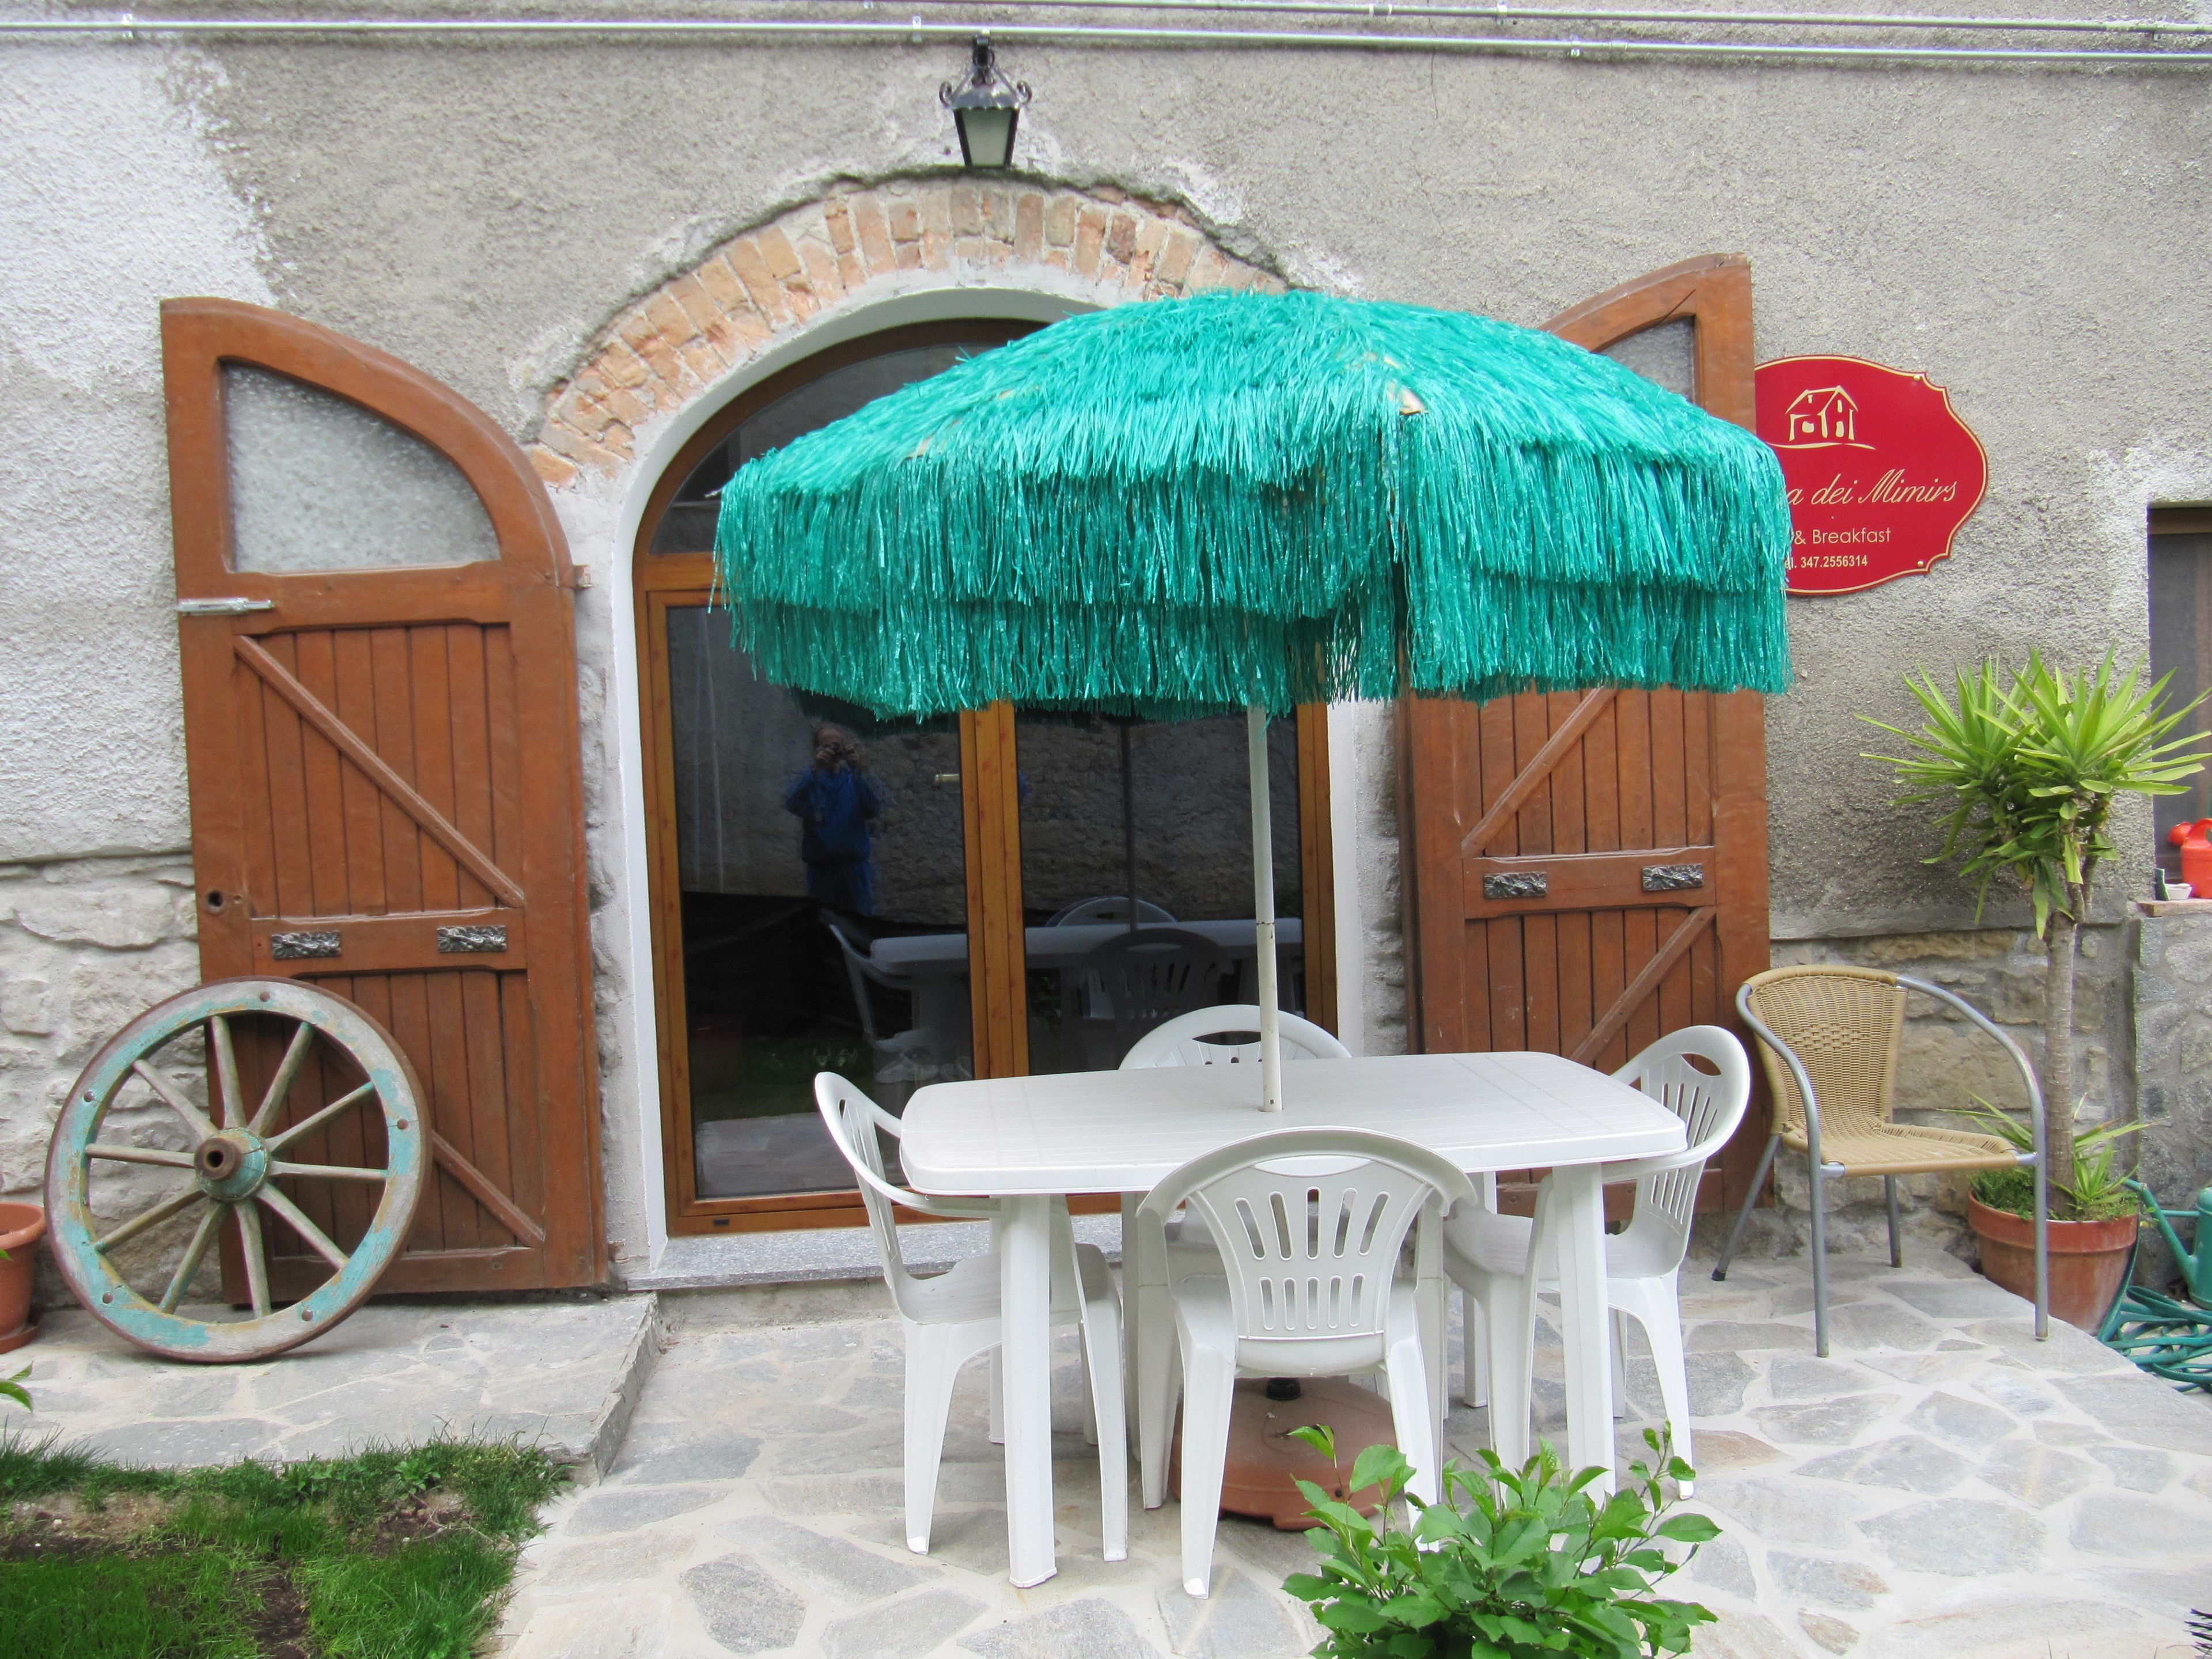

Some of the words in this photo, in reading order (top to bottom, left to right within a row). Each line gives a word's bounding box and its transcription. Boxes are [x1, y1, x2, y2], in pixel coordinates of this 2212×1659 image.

[1786, 488, 1805, 505] a
[1811, 473, 1858, 505] dei
[1858, 468, 1957, 503] Mimirs
[1794, 530, 1806, 545] &
[1813, 527, 1891, 544] Breakfast
[1800, 555, 1868, 568] 347.2556314
